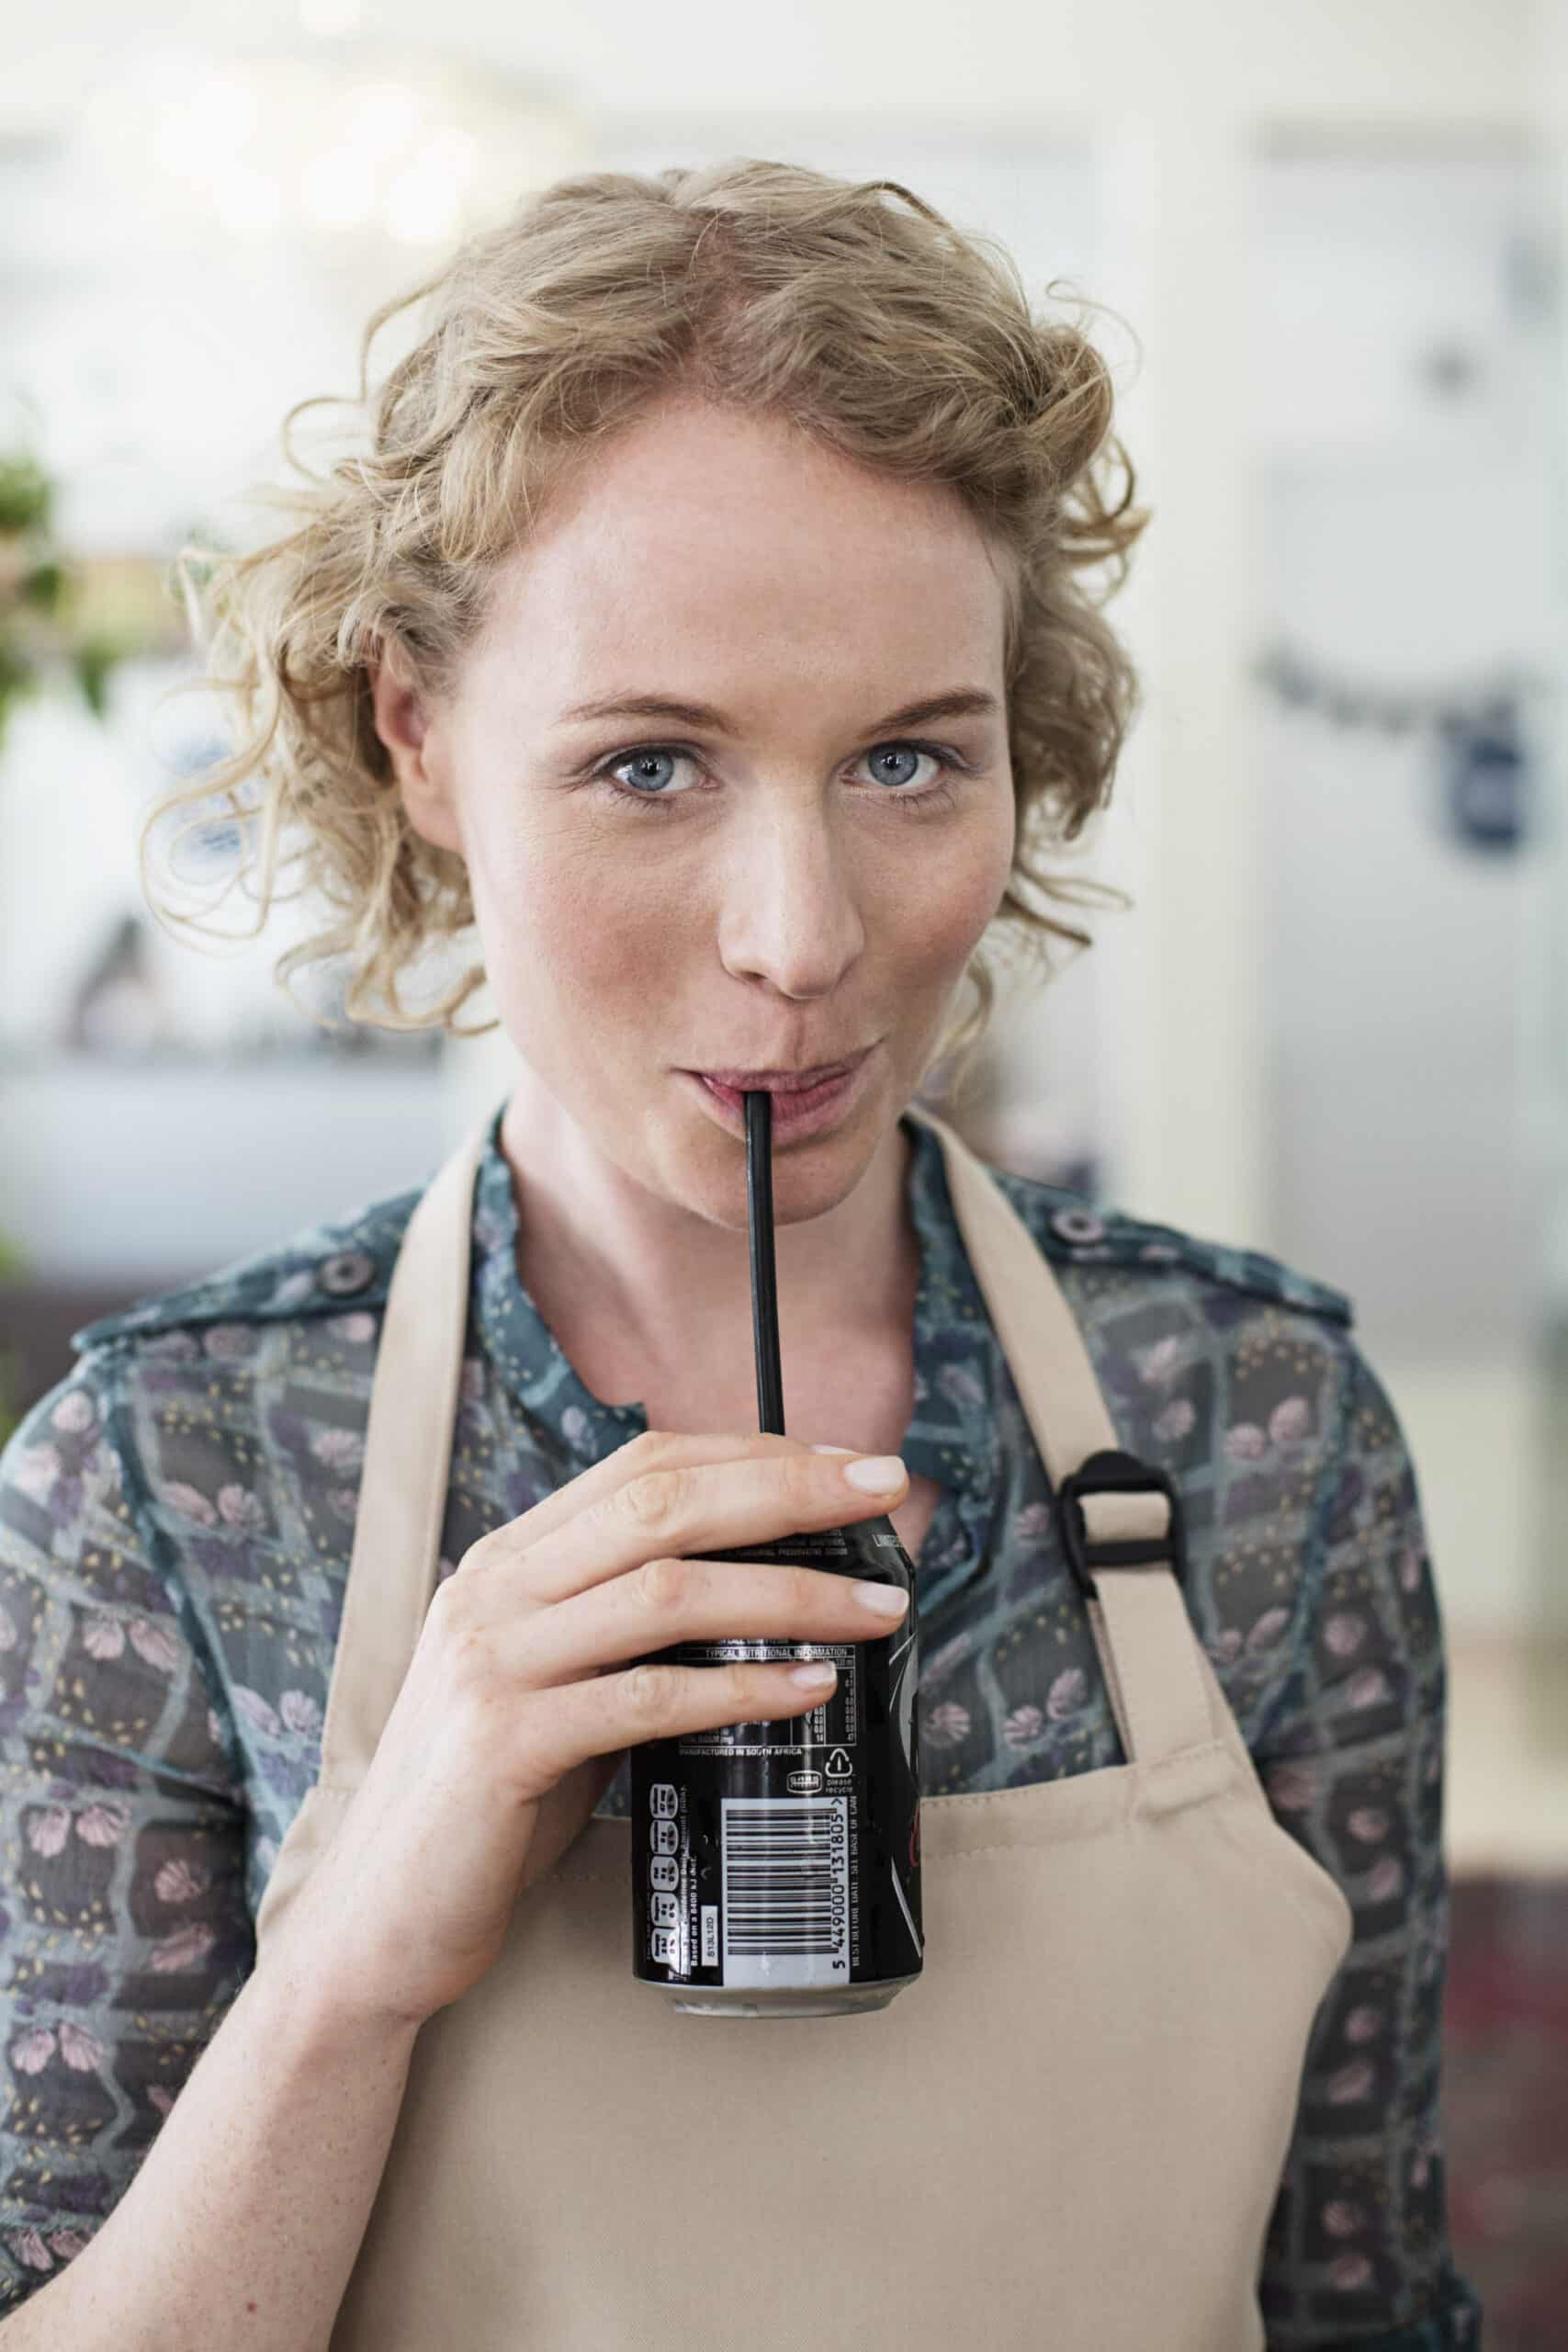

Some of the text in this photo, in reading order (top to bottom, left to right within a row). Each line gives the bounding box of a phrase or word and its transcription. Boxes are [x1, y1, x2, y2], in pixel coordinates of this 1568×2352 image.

[705, 1646, 847, 1658] TYPICAL NUTRITIONAL INFORMATION
[679, 1747, 802, 1757] MANUFACTURED IN SOUTH AFRICA
[827, 1779, 852, 1787] please
[849, 1795, 858, 1815] CAN
[850, 1819, 858, 1829] OF
[830, 1814, 844, 1874] 131805
[850, 1833, 858, 1855] BASE
[851, 1860, 859, 1874] SEE
[691, 1879, 697, 1891] kJ
[831, 1884, 845, 1948] 449000
[691, 1925, 697, 1936] on
[851, 1907, 860, 1940] BEFORE
[706, 1917, 715, 1957] S13L12D
[851, 1944, 860, 1966] BEST
[832, 1961, 845, 1969] 5
